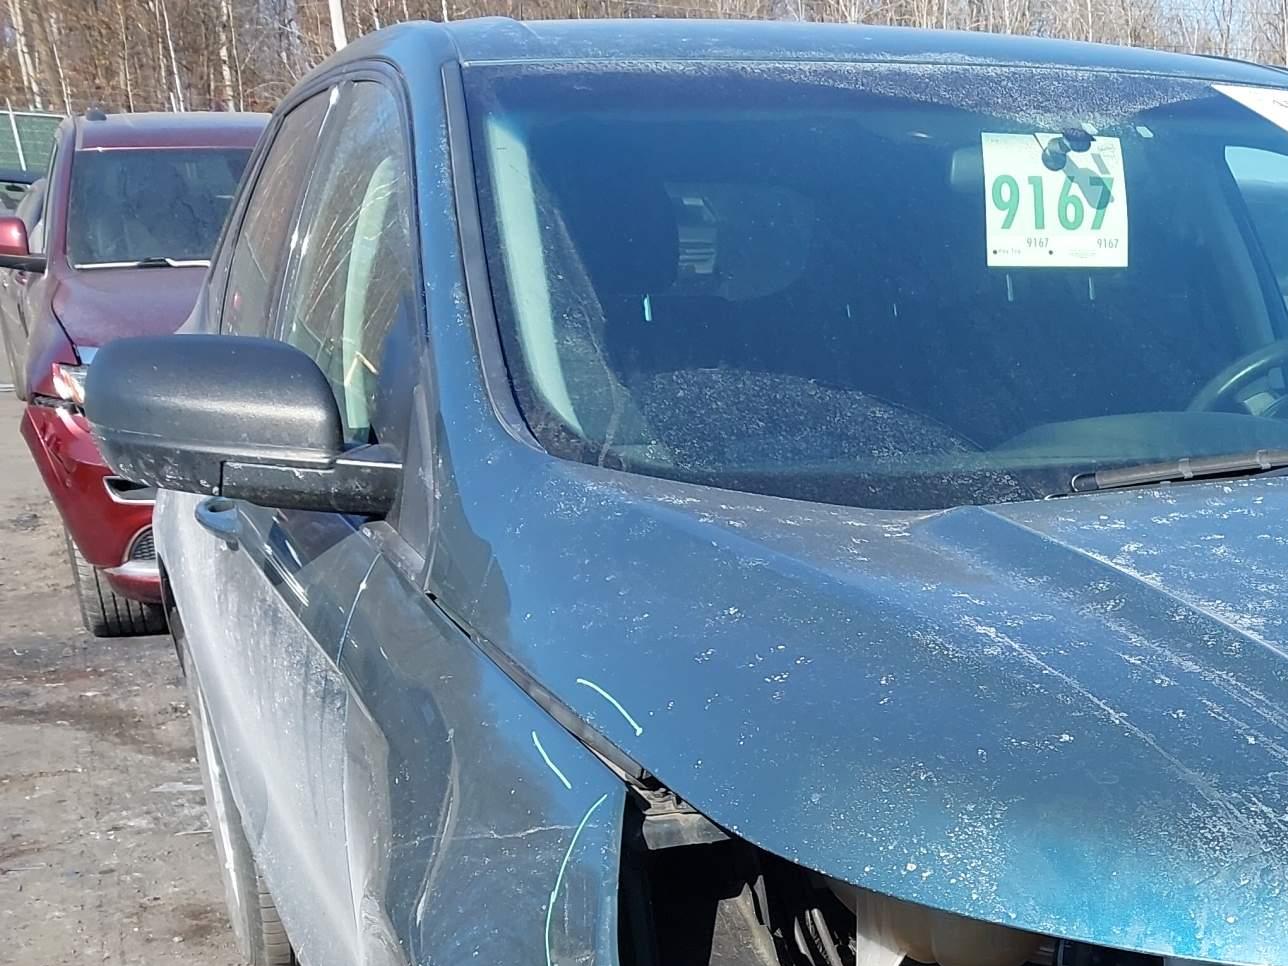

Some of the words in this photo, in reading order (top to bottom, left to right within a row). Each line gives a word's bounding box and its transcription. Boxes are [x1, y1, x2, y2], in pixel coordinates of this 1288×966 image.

[991, 174, 1115, 231] 9167
[1026, 237, 1050, 249] 9167
[1096, 238, 1120, 249] 9167
